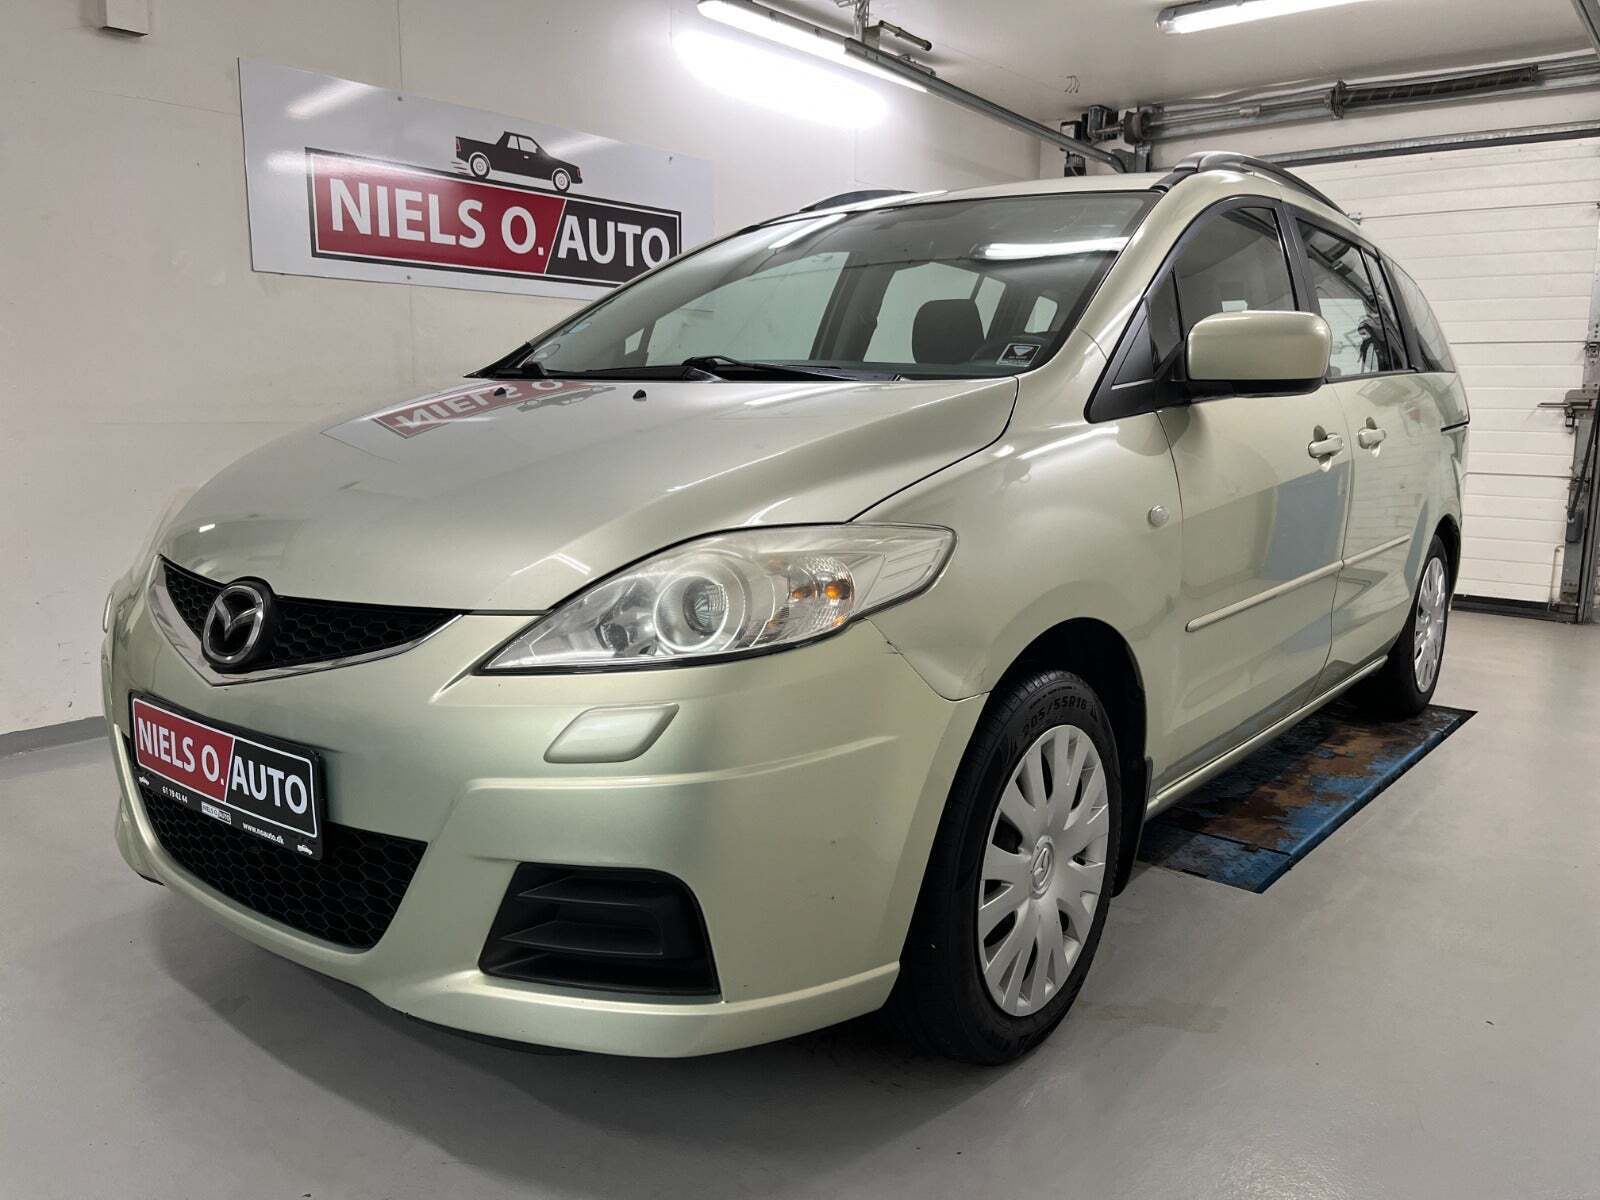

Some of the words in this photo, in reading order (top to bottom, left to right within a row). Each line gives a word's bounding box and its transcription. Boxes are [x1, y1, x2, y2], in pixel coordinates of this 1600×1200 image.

[329, 178, 486, 248] NIELS
[501, 206, 544, 256] O.
[557, 215, 670, 268] AUTO
[137, 717, 196, 773] NIELS
[201, 745, 225, 785] O.
[231, 755, 308, 814] AUTO
